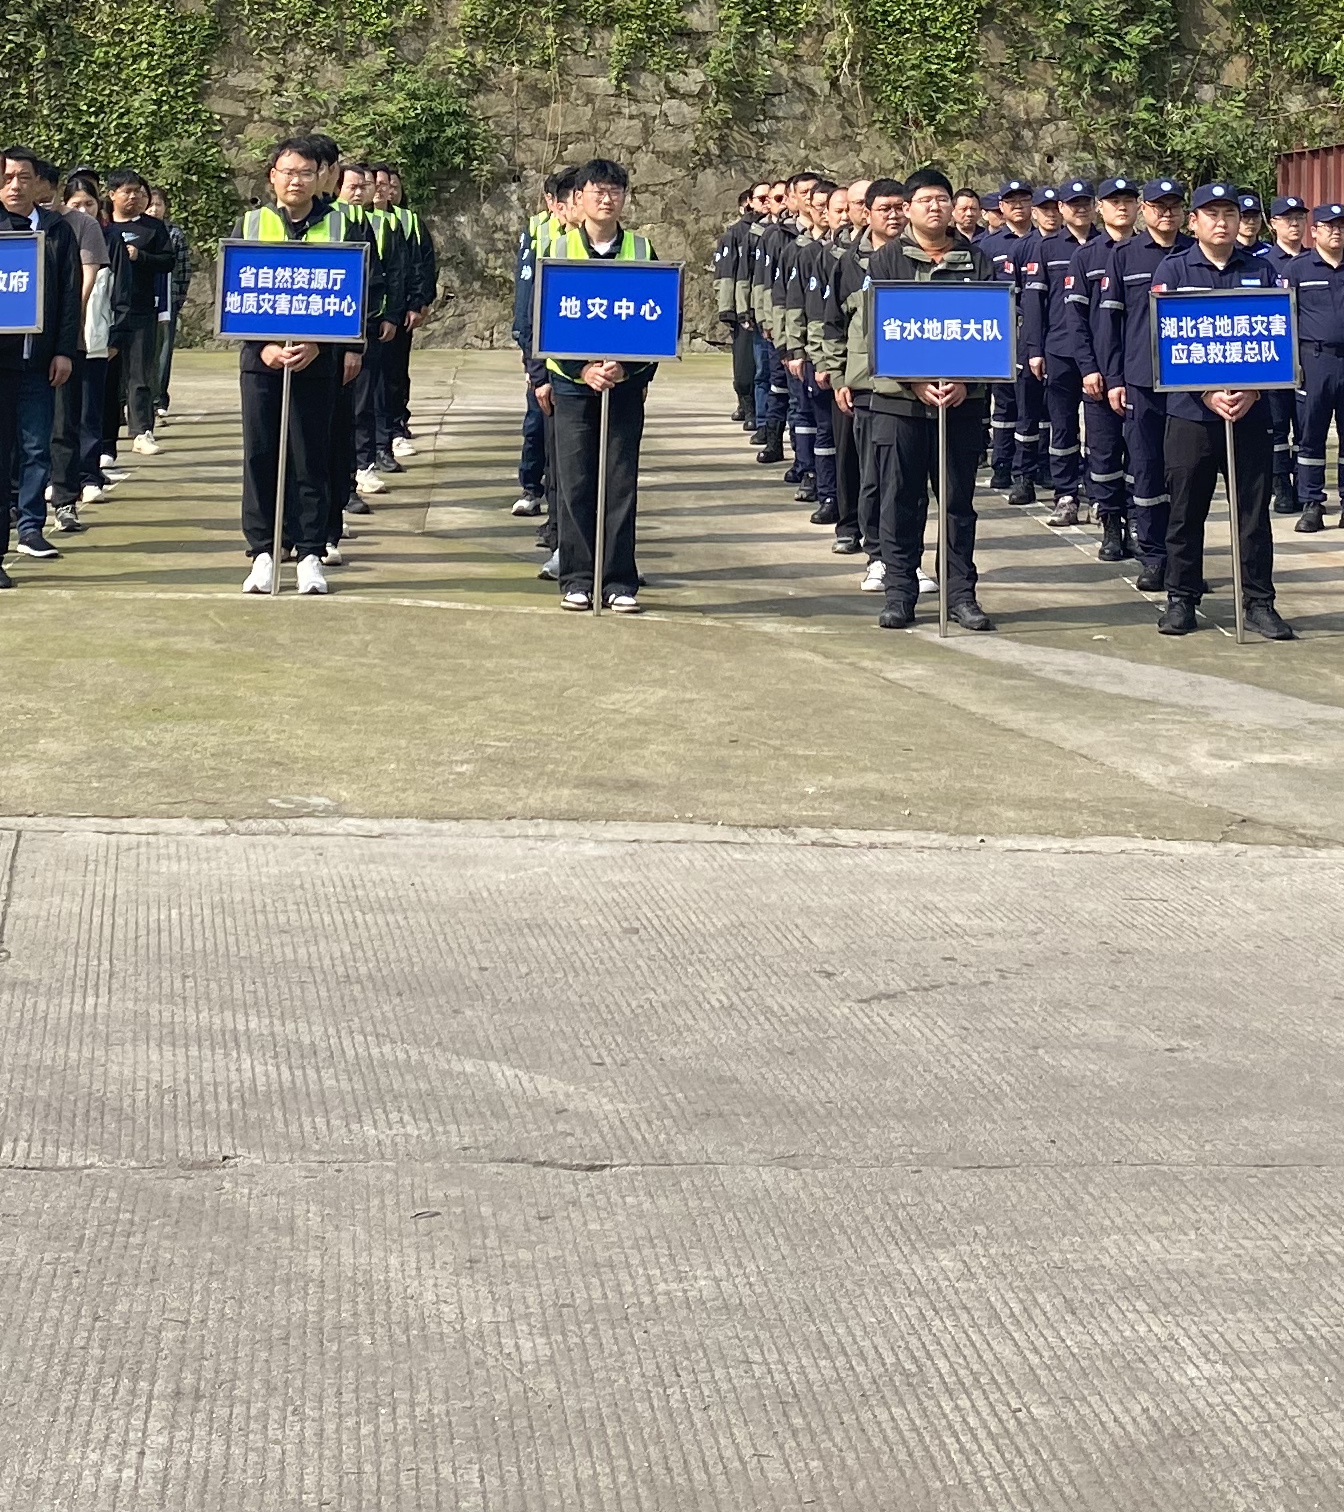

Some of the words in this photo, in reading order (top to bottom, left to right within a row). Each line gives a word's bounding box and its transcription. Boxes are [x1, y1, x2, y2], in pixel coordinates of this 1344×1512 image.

[238, 265, 346, 290] 省自然资源厅
[224, 291, 356, 317] 地质灾害应急中心
[560, 296, 661, 320] 地灾中心
[882, 317, 1002, 341] 省水地质大队
[1160, 314, 1287, 338] 湖北省地质灾害
[1171, 340, 1279, 364] 应急救援总队
